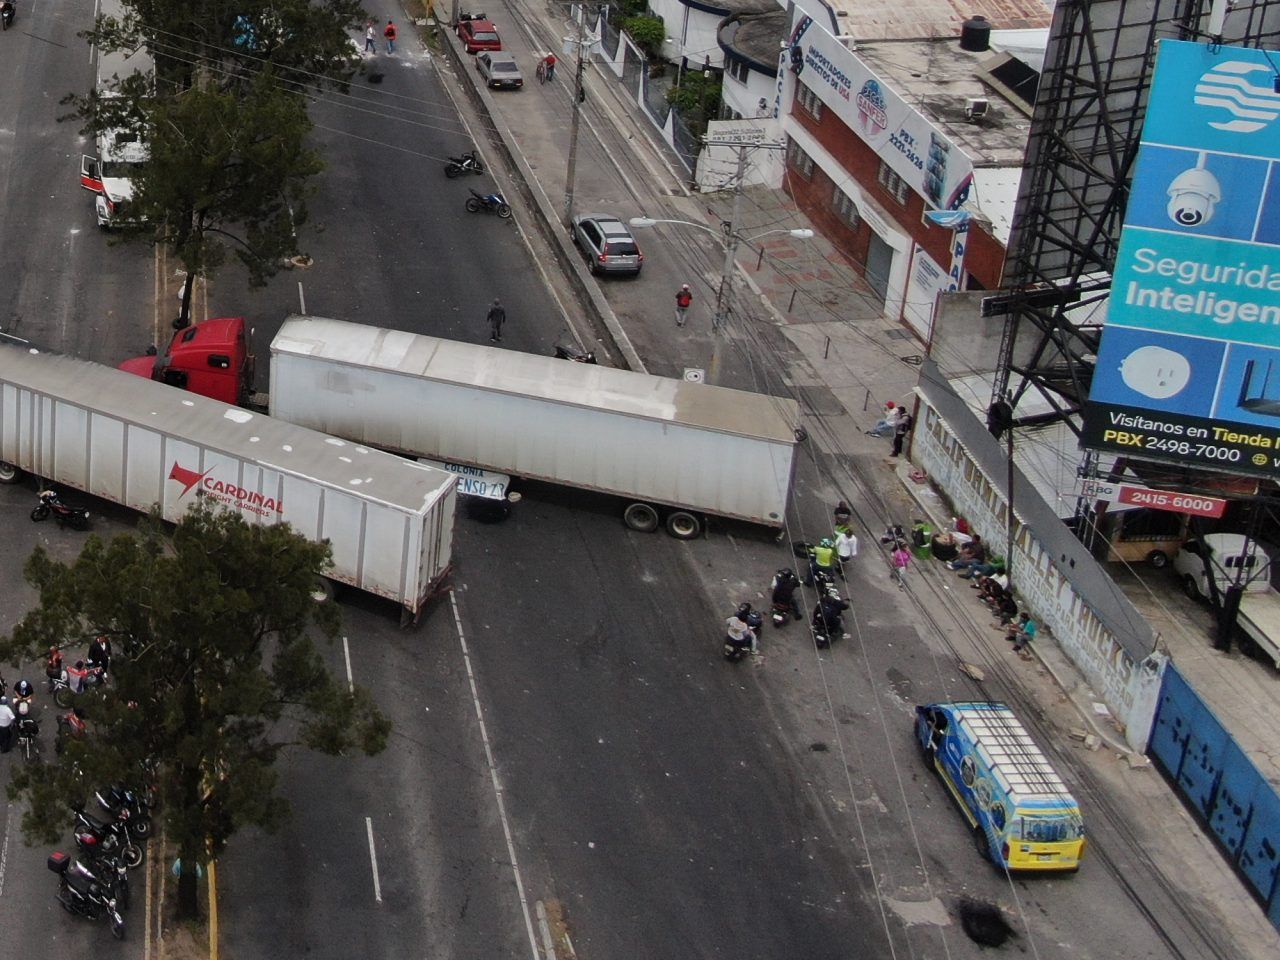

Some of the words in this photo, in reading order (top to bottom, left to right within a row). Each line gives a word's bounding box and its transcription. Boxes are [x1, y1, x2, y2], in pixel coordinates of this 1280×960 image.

[772, 53, 786, 119] PACAS
[838, 85, 850, 102] USA
[1109, 411, 1184, 436] Visítanos
[1186, 426, 1208, 439] en
[1212, 427, 1272, 448] Tienda
[1103, 429, 1144, 448] PBX
[1145, 436, 1241, 462] 2498-7000
[444, 463, 484, 477] COLONIA
[203, 477, 284, 514] CARDINAL
[1132, 492, 1214, 512] 2415-6000
[234, 500, 271, 518] CARRIERS
